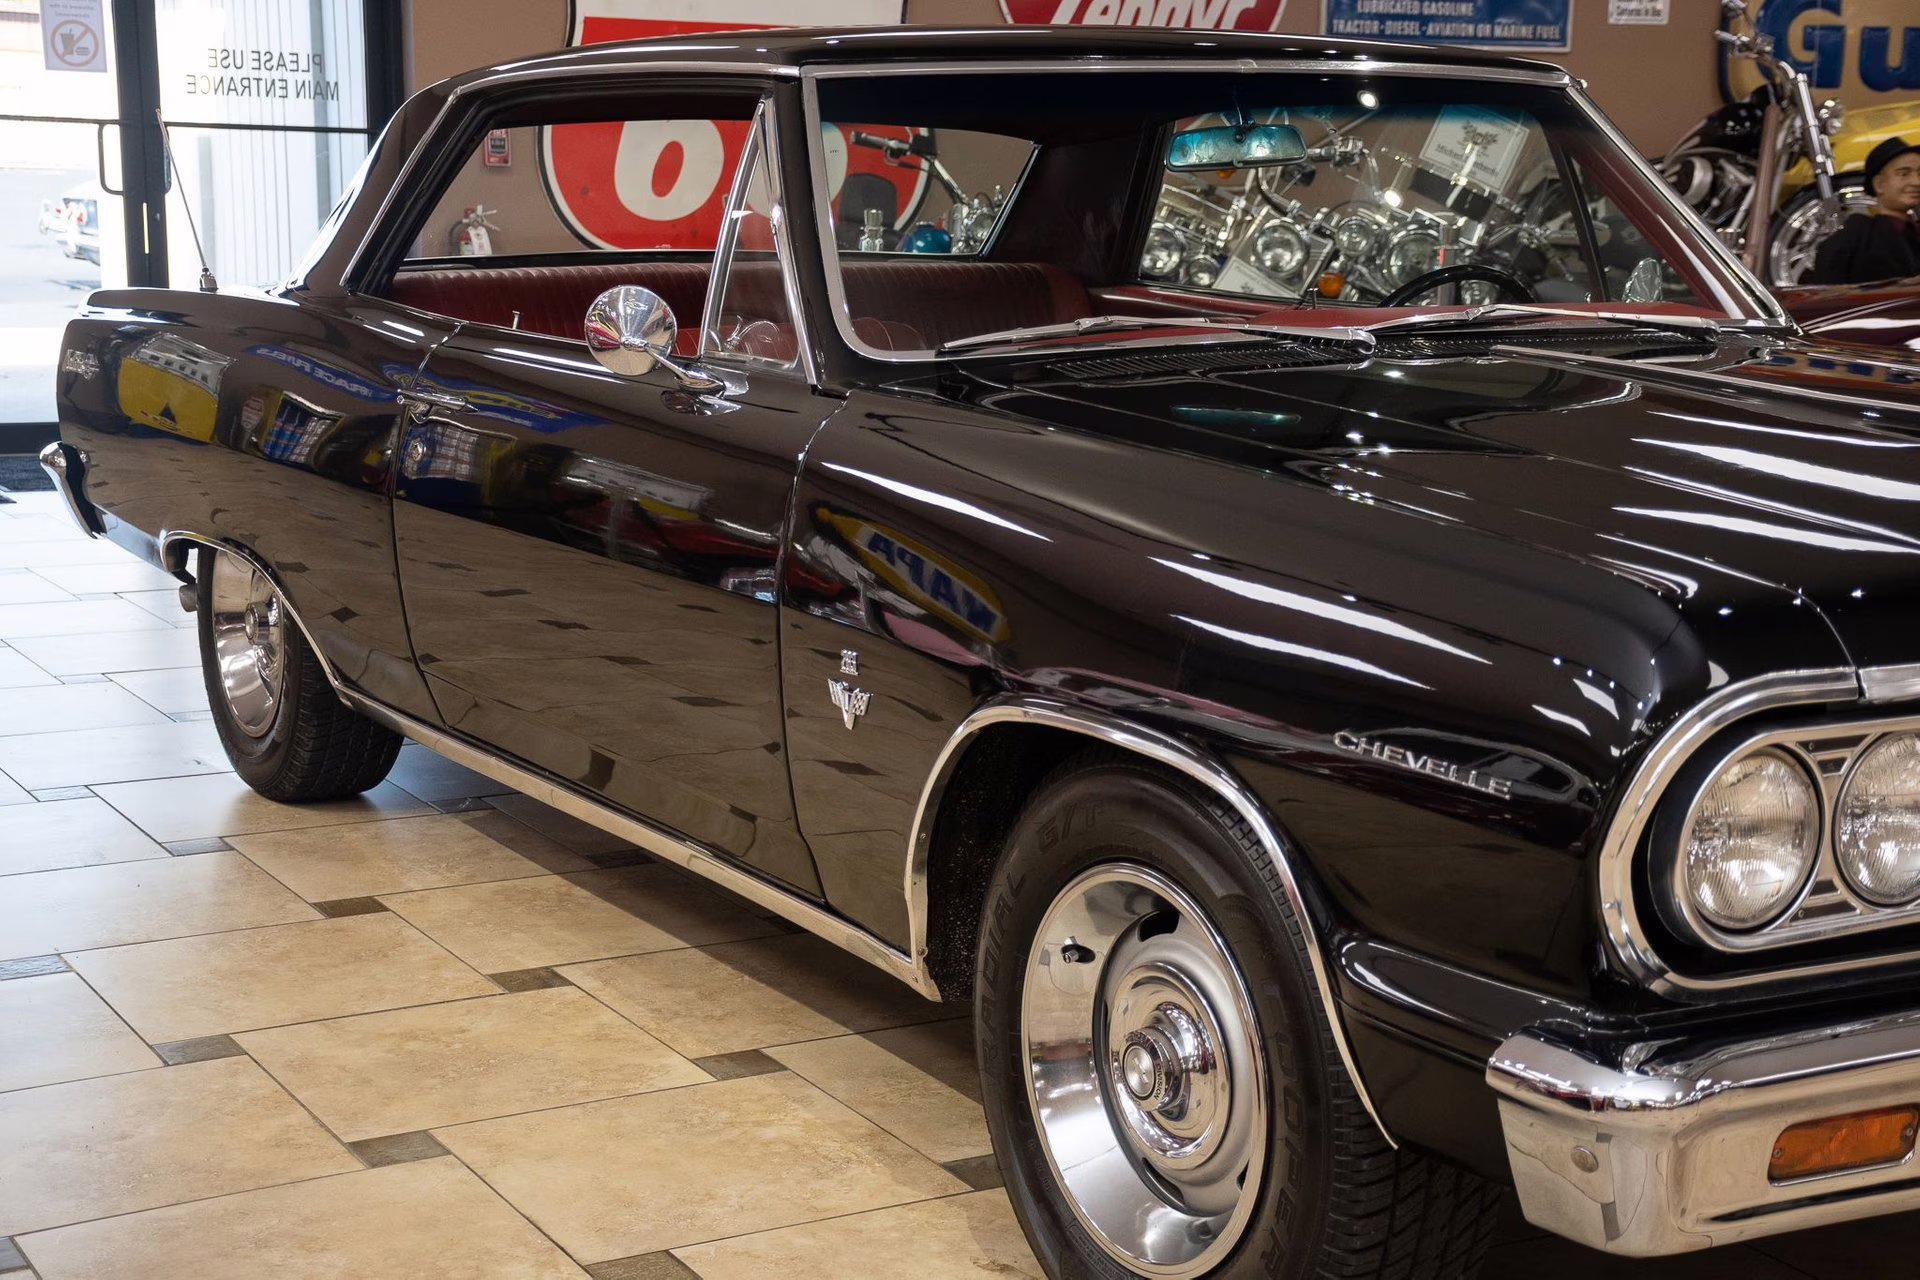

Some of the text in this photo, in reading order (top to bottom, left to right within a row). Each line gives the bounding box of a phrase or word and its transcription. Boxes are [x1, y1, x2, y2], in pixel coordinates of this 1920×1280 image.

[1422, 1, 1474, 16] GASOLINE
[1476, 23, 1492, 38] OR
[1493, 24, 1535, 39] MARINE
[1535, 25, 1560, 40] FUEL
[1332, 731, 1513, 801] CHEVELLE
[1153, 1062, 1166, 1101] DIVISION
